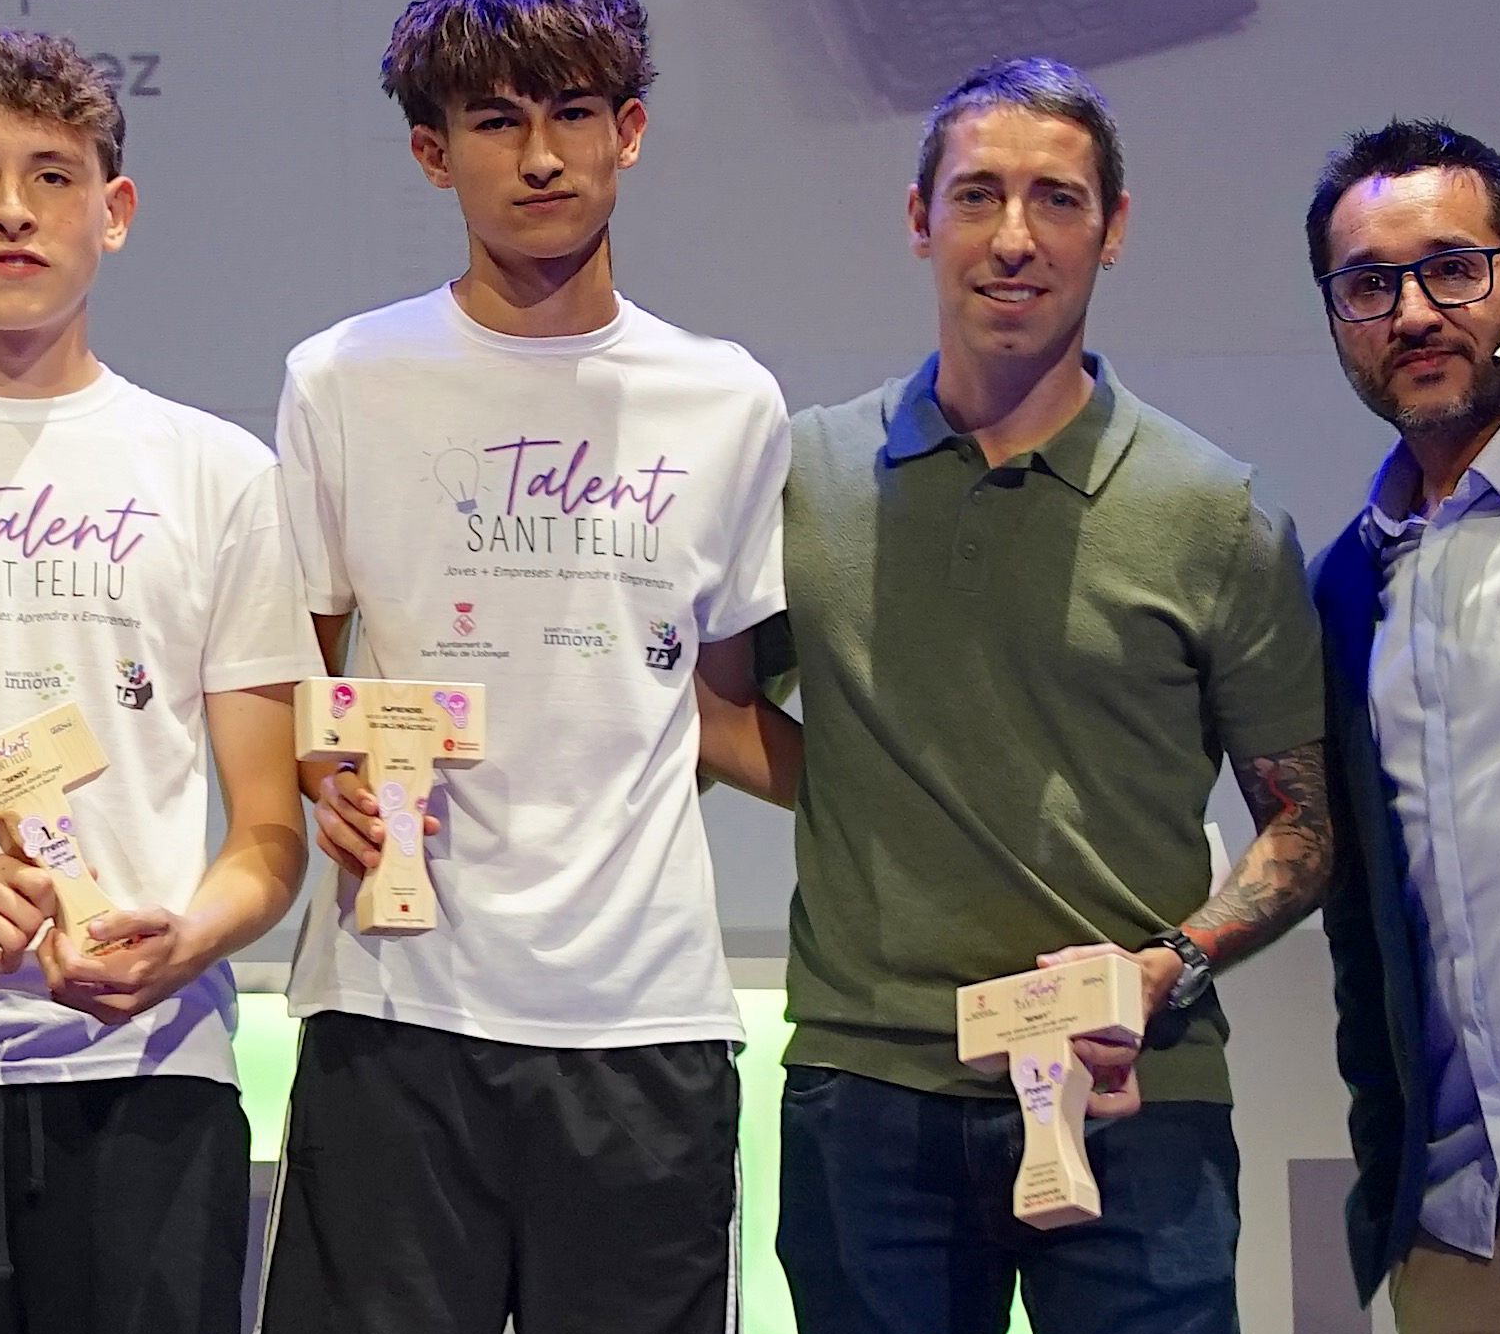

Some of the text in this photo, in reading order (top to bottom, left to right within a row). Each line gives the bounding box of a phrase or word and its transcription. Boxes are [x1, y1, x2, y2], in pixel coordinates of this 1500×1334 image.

[484, 436, 689, 524] Talent
[466, 513, 660, 563] SANT FELIU
[35, 559, 126, 601] FELIU
[444, 565, 477, 577] Joves
[543, 633, 604, 648] innova
[4, 676, 62, 690] innova
